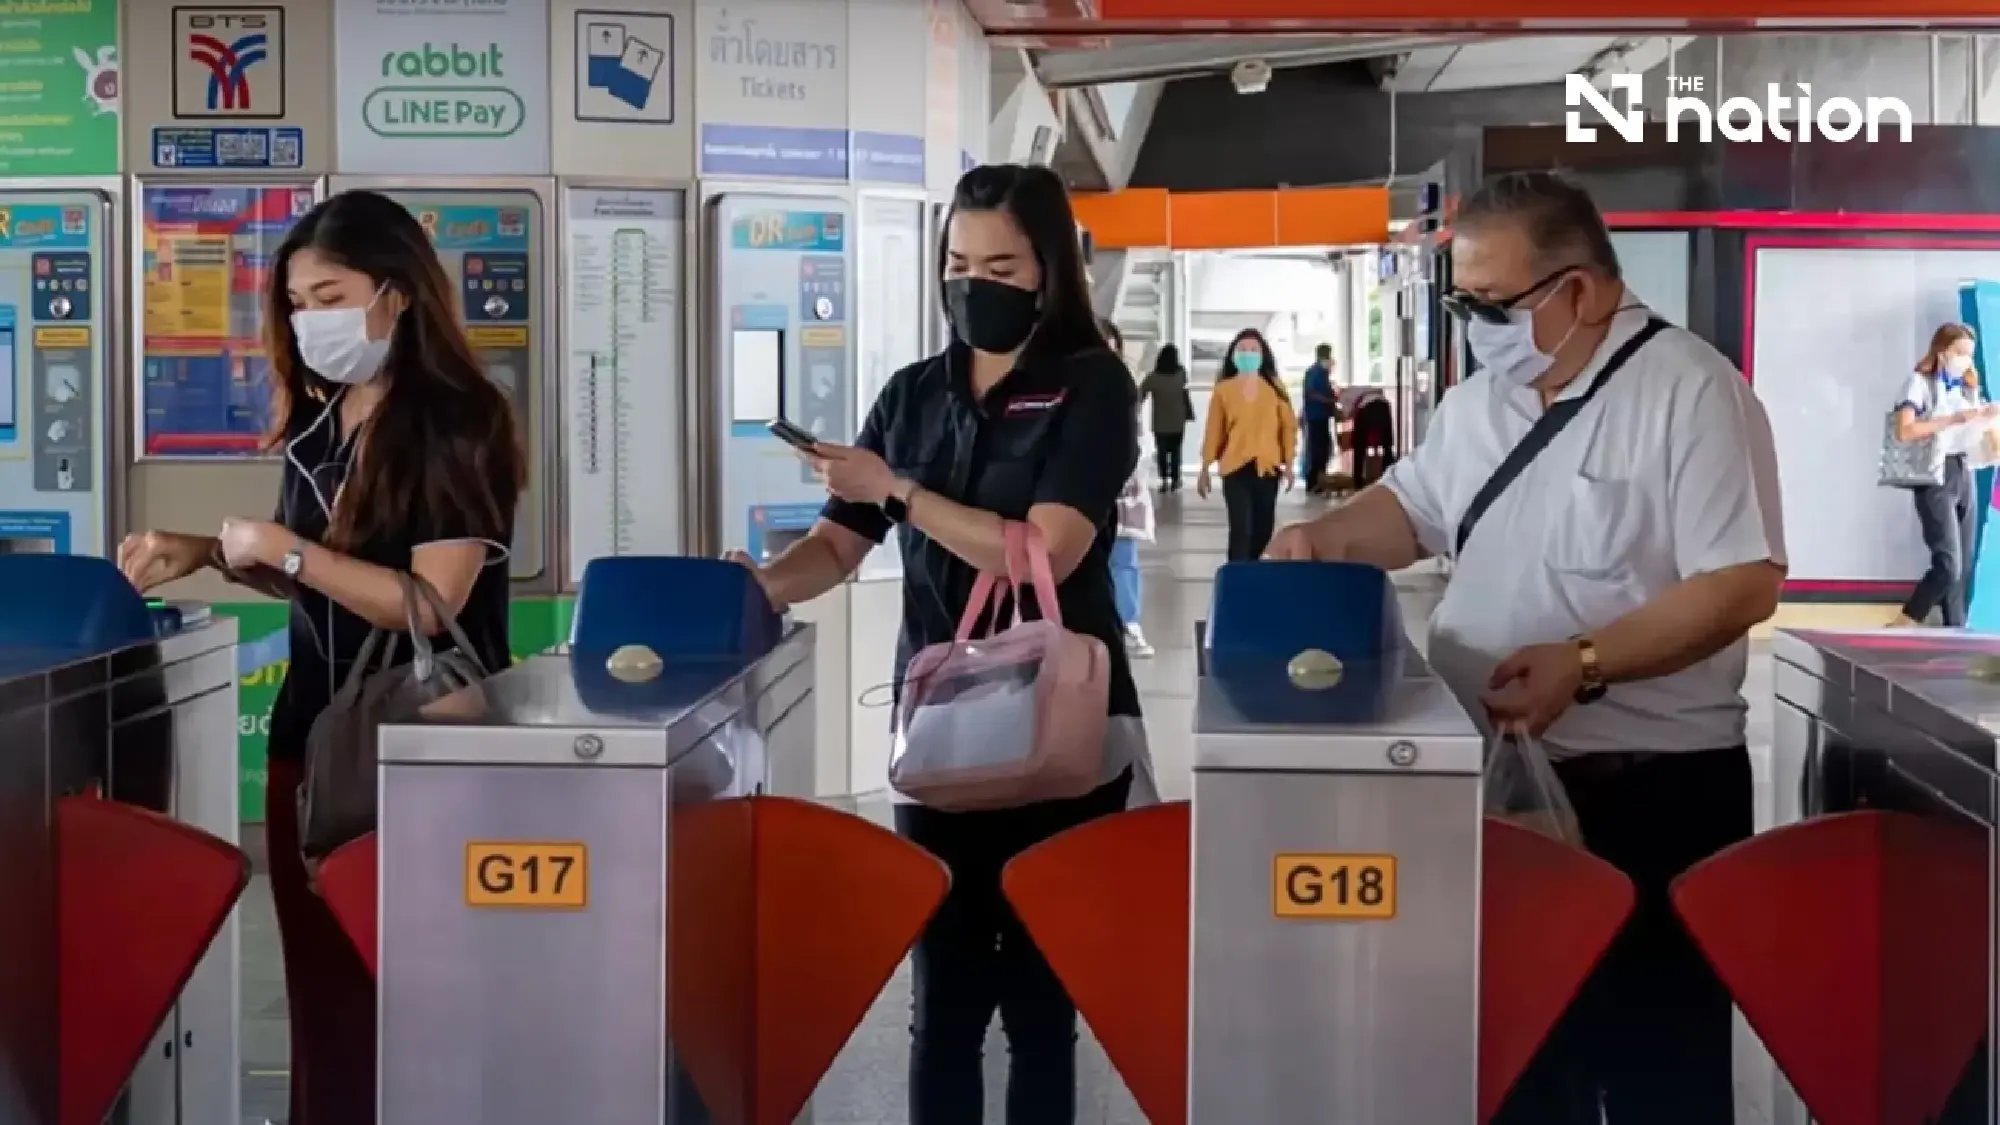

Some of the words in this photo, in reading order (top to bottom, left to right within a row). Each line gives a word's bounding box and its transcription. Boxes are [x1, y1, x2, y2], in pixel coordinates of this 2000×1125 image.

[189, 14, 267, 29] BTS
[381, 42, 504, 77] rabbit
[740, 76, 806, 101] Tickets
[384, 100, 449, 124] LINE
[455, 101, 506, 128] Pay
[477, 853, 575, 895] G17
[1286, 864, 1384, 906] G18
